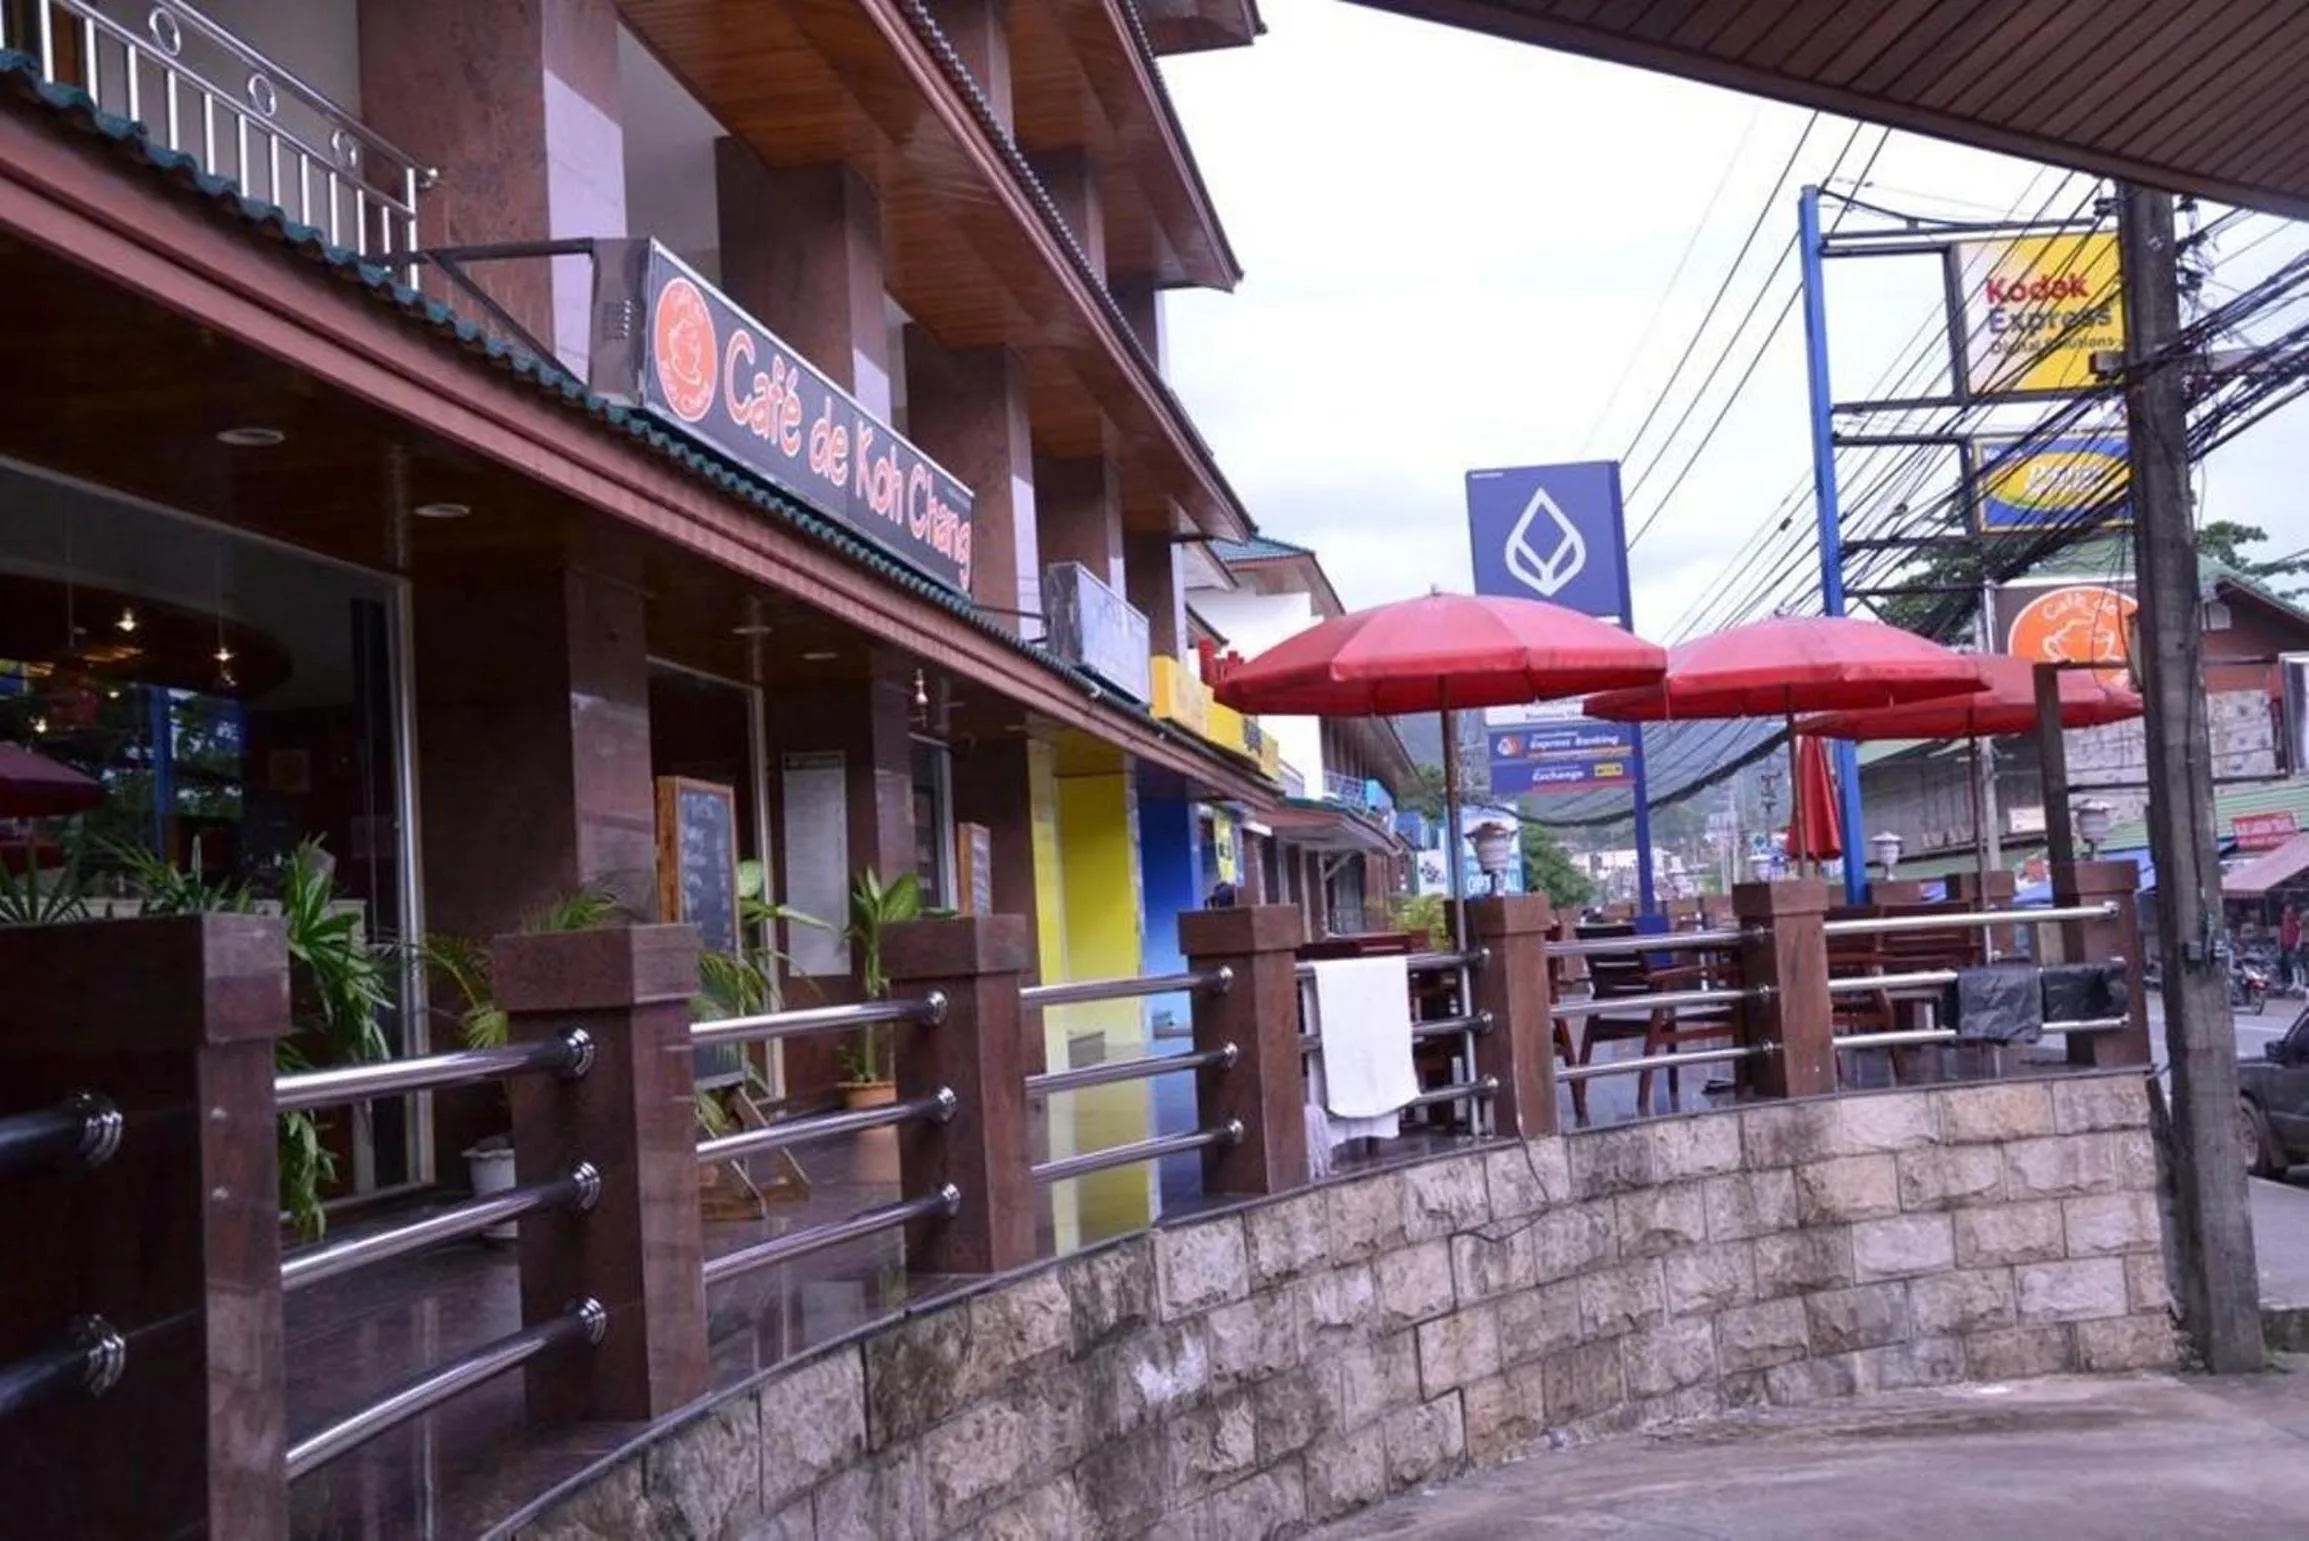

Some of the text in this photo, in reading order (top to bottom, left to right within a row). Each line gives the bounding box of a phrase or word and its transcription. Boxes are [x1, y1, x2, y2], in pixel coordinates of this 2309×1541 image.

[1986, 272, 2089, 304] Kodak
[1988, 304, 2112, 335] Express
[724, 329, 802, 458] Café
[808, 395, 849, 487] de
[856, 419, 905, 525] Koh
[908, 462, 972, 592] Chang
[1531, 769, 1585, 782] Exchange
